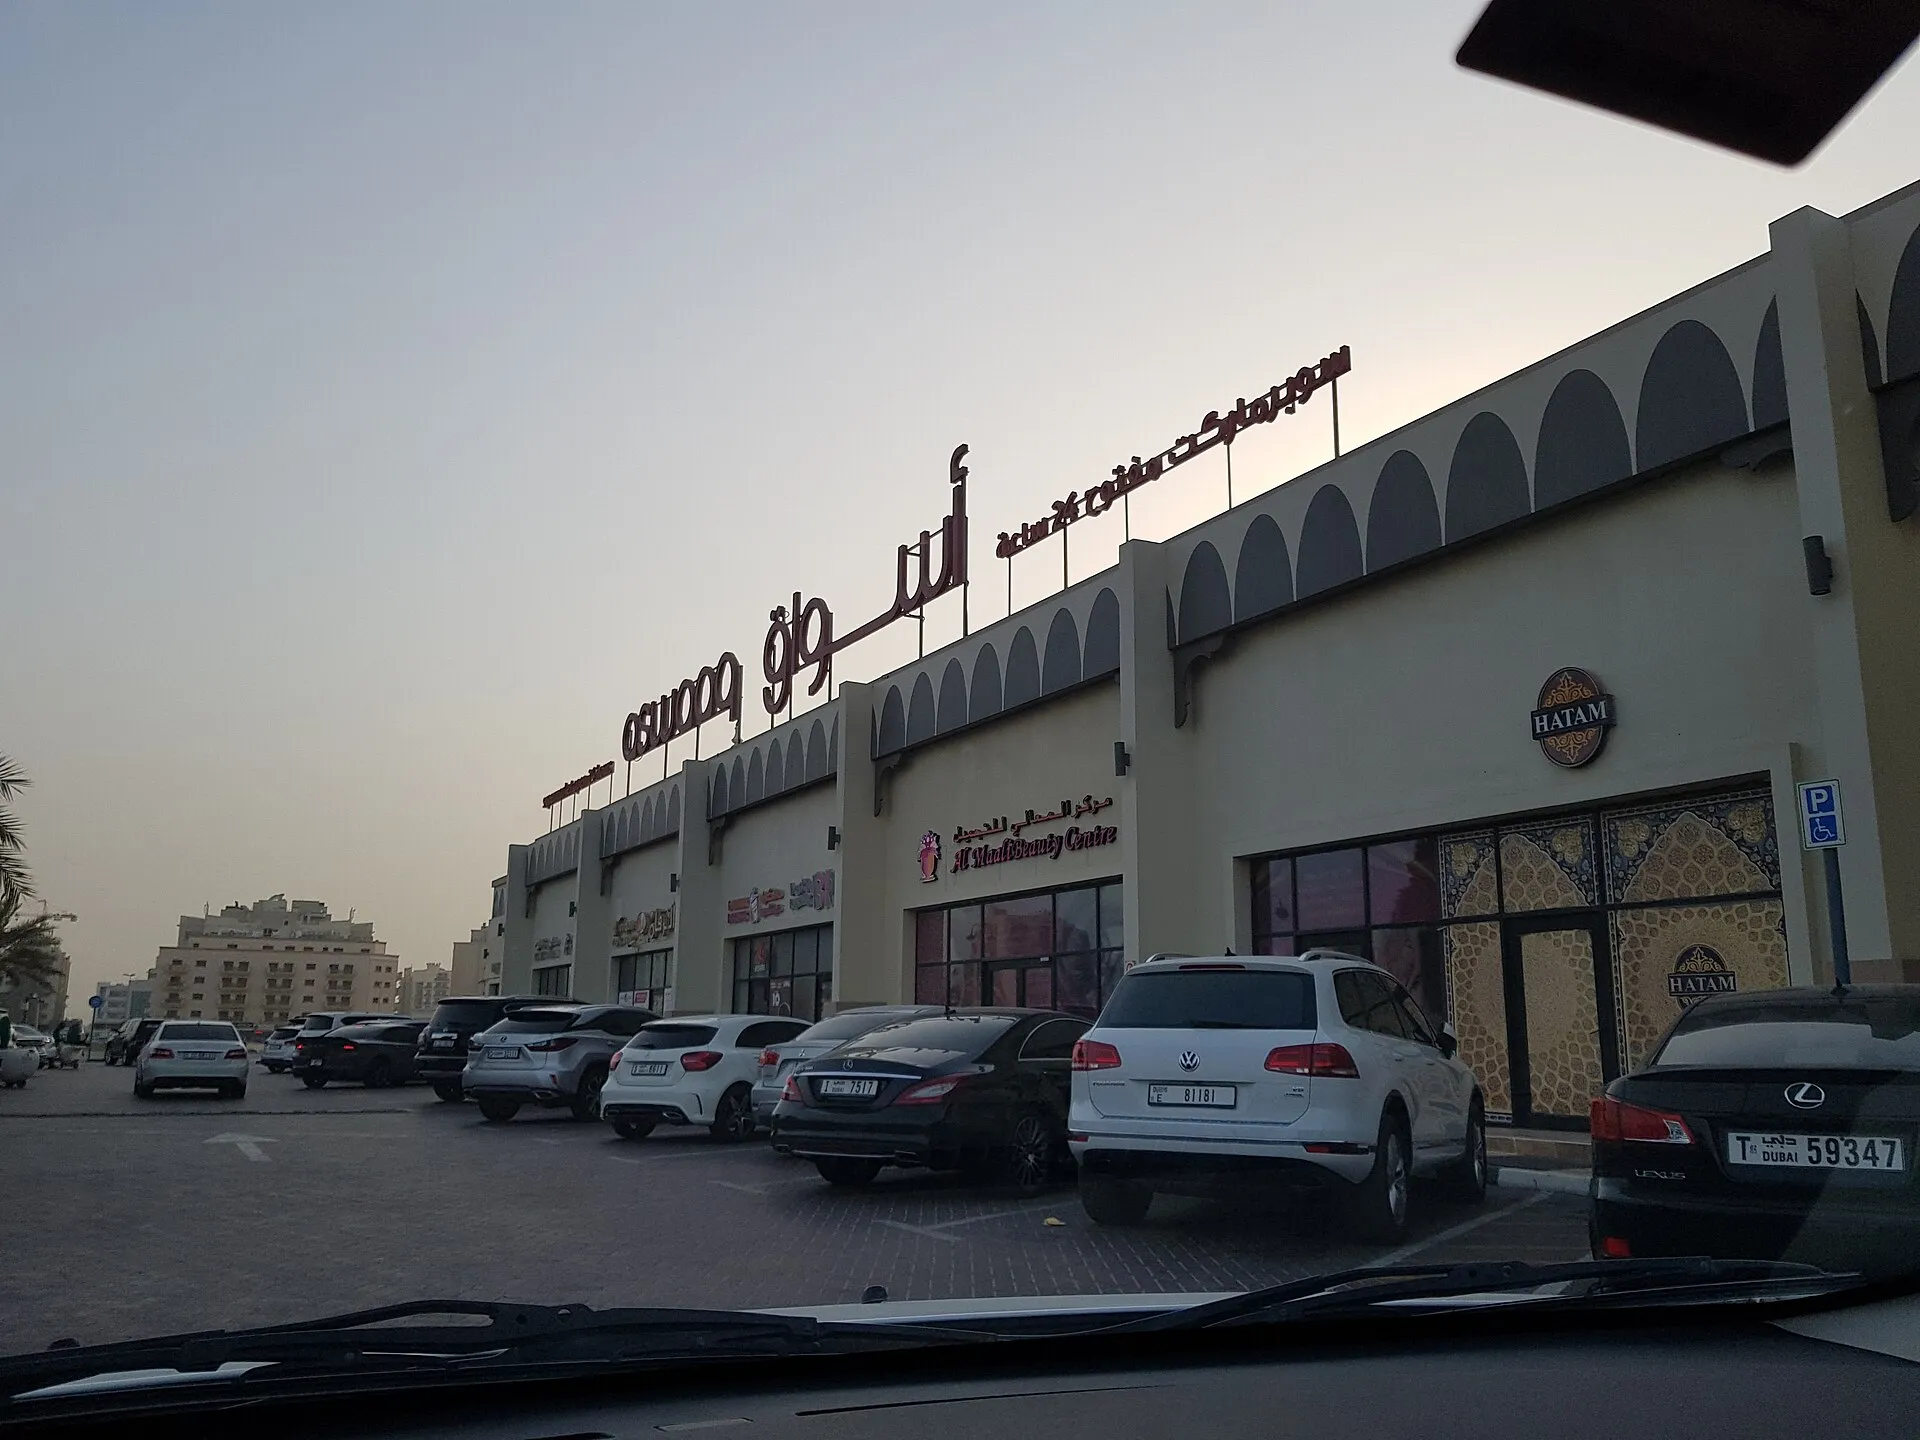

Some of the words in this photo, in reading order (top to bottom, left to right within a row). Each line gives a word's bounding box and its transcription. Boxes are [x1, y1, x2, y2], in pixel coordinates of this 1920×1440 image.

[1085, 456, 1164, 517] مفتوح
[995, 517, 1050, 559] ساعة
[1533, 699, 1608, 734] HATAM
[1071, 794, 1114, 818] مركز
[1810, 788, 1829, 812] P
[1014, 834, 1064, 860] Beauty
[1064, 825, 1118, 851] Centre
[1670, 975, 1736, 993] HATAM
[850, 1081, 874, 1094] 7517
[1156, 1093, 1163, 1103] E
[1184, 1088, 1215, 1103] 81181
[1736, 1135, 1751, 1161] T
[1762, 1151, 1799, 1163] DUBAI
[1807, 1137, 1897, 1168] 59347
